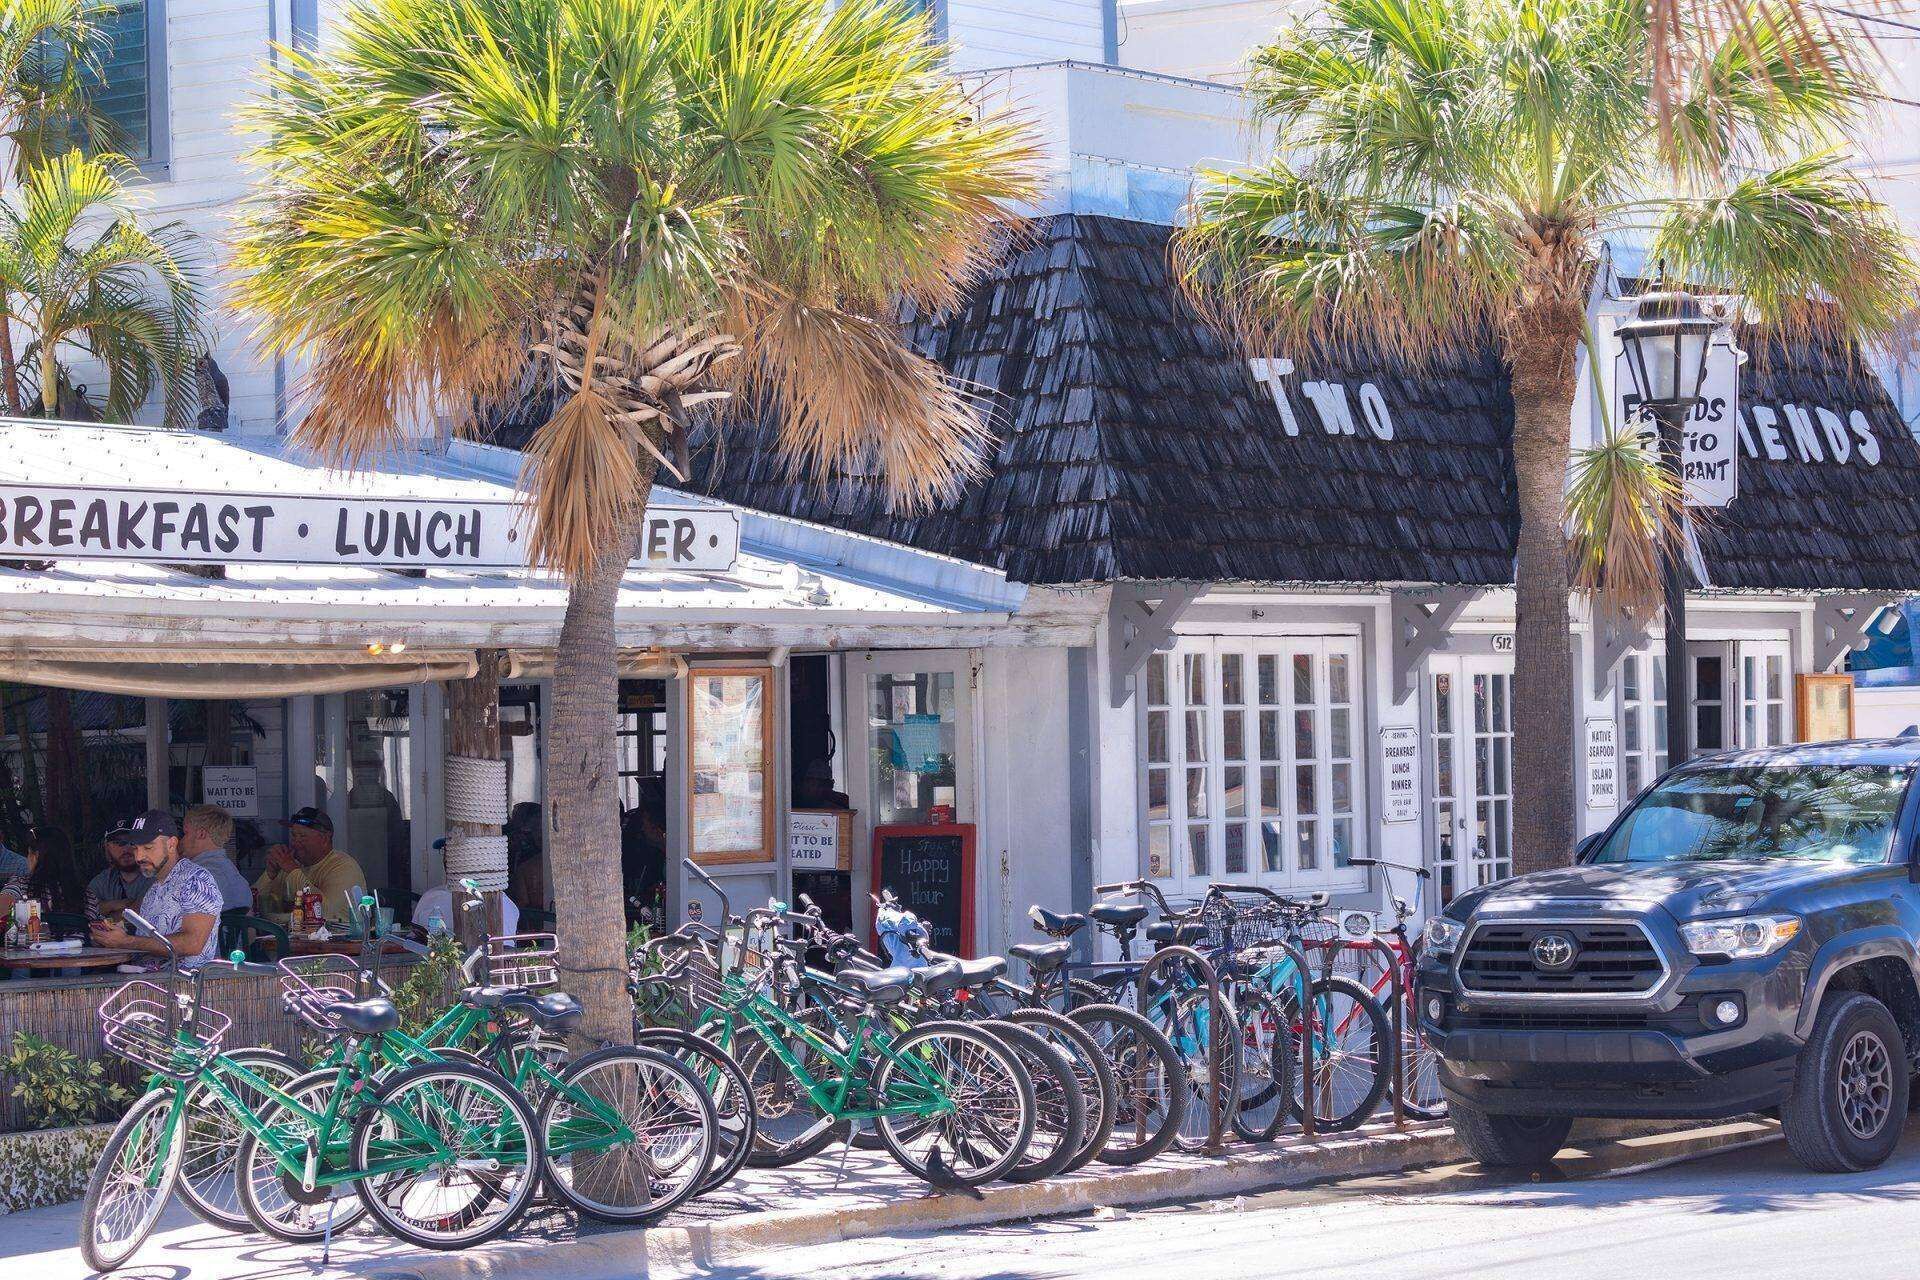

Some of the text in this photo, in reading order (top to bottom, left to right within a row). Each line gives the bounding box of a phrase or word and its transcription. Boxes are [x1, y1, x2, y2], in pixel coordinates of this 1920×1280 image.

[1250, 358, 1395, 441] TWO
[1737, 404, 1881, 466] IENDS
[0, 495, 481, 559] REAKFAST LUNCH
[1496, 636, 1512, 649] 512
[1591, 730, 1611, 742] NATIVE
[1385, 746, 1416, 758] BREAKFAST
[1588, 746, 1615, 757] SEAFOOD
[1391, 763, 1410, 774] LUNCH
[1591, 768, 1613, 780] ISLAND
[1391, 779, 1412, 790] DINNER
[1591, 783, 1613, 795] DRINKS
[206, 787, 256, 796] WAIT TO BE
[216, 800, 246, 809] SEATED
[803, 836, 818, 845] TO
[821, 836, 833, 845] BE
[791, 849, 822, 859] EATED
[900, 848, 949, 882] Happy
[911, 881, 944, 905] Hour
